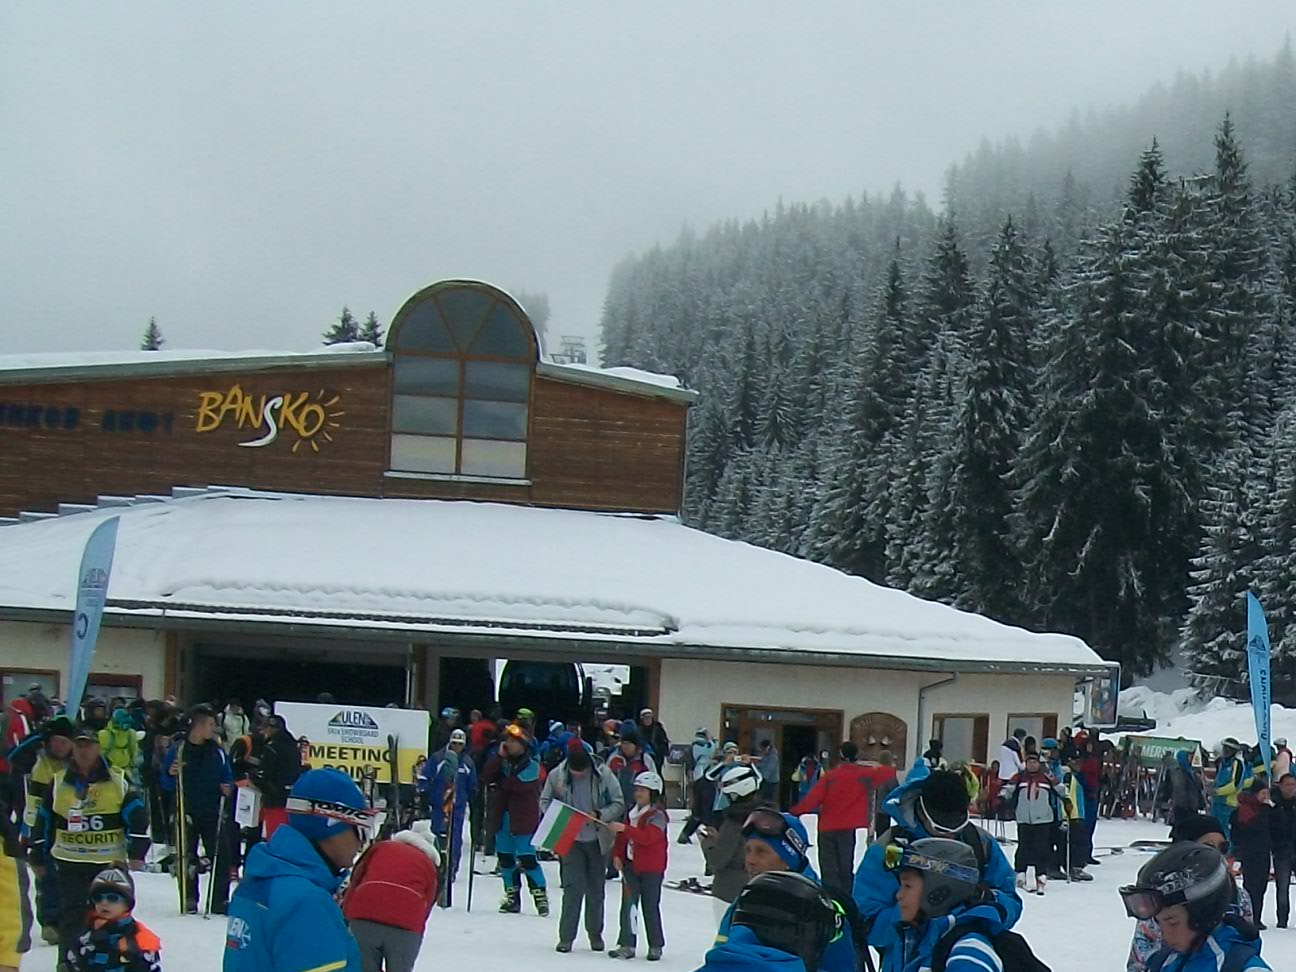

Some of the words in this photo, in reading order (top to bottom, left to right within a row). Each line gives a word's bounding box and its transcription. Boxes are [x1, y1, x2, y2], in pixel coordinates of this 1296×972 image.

[195, 384, 324, 447] BANSKO
[341, 711, 366, 725] ULEN
[341, 736, 364, 745] SCHOOL
[61, 832, 121, 845] SECURITY
